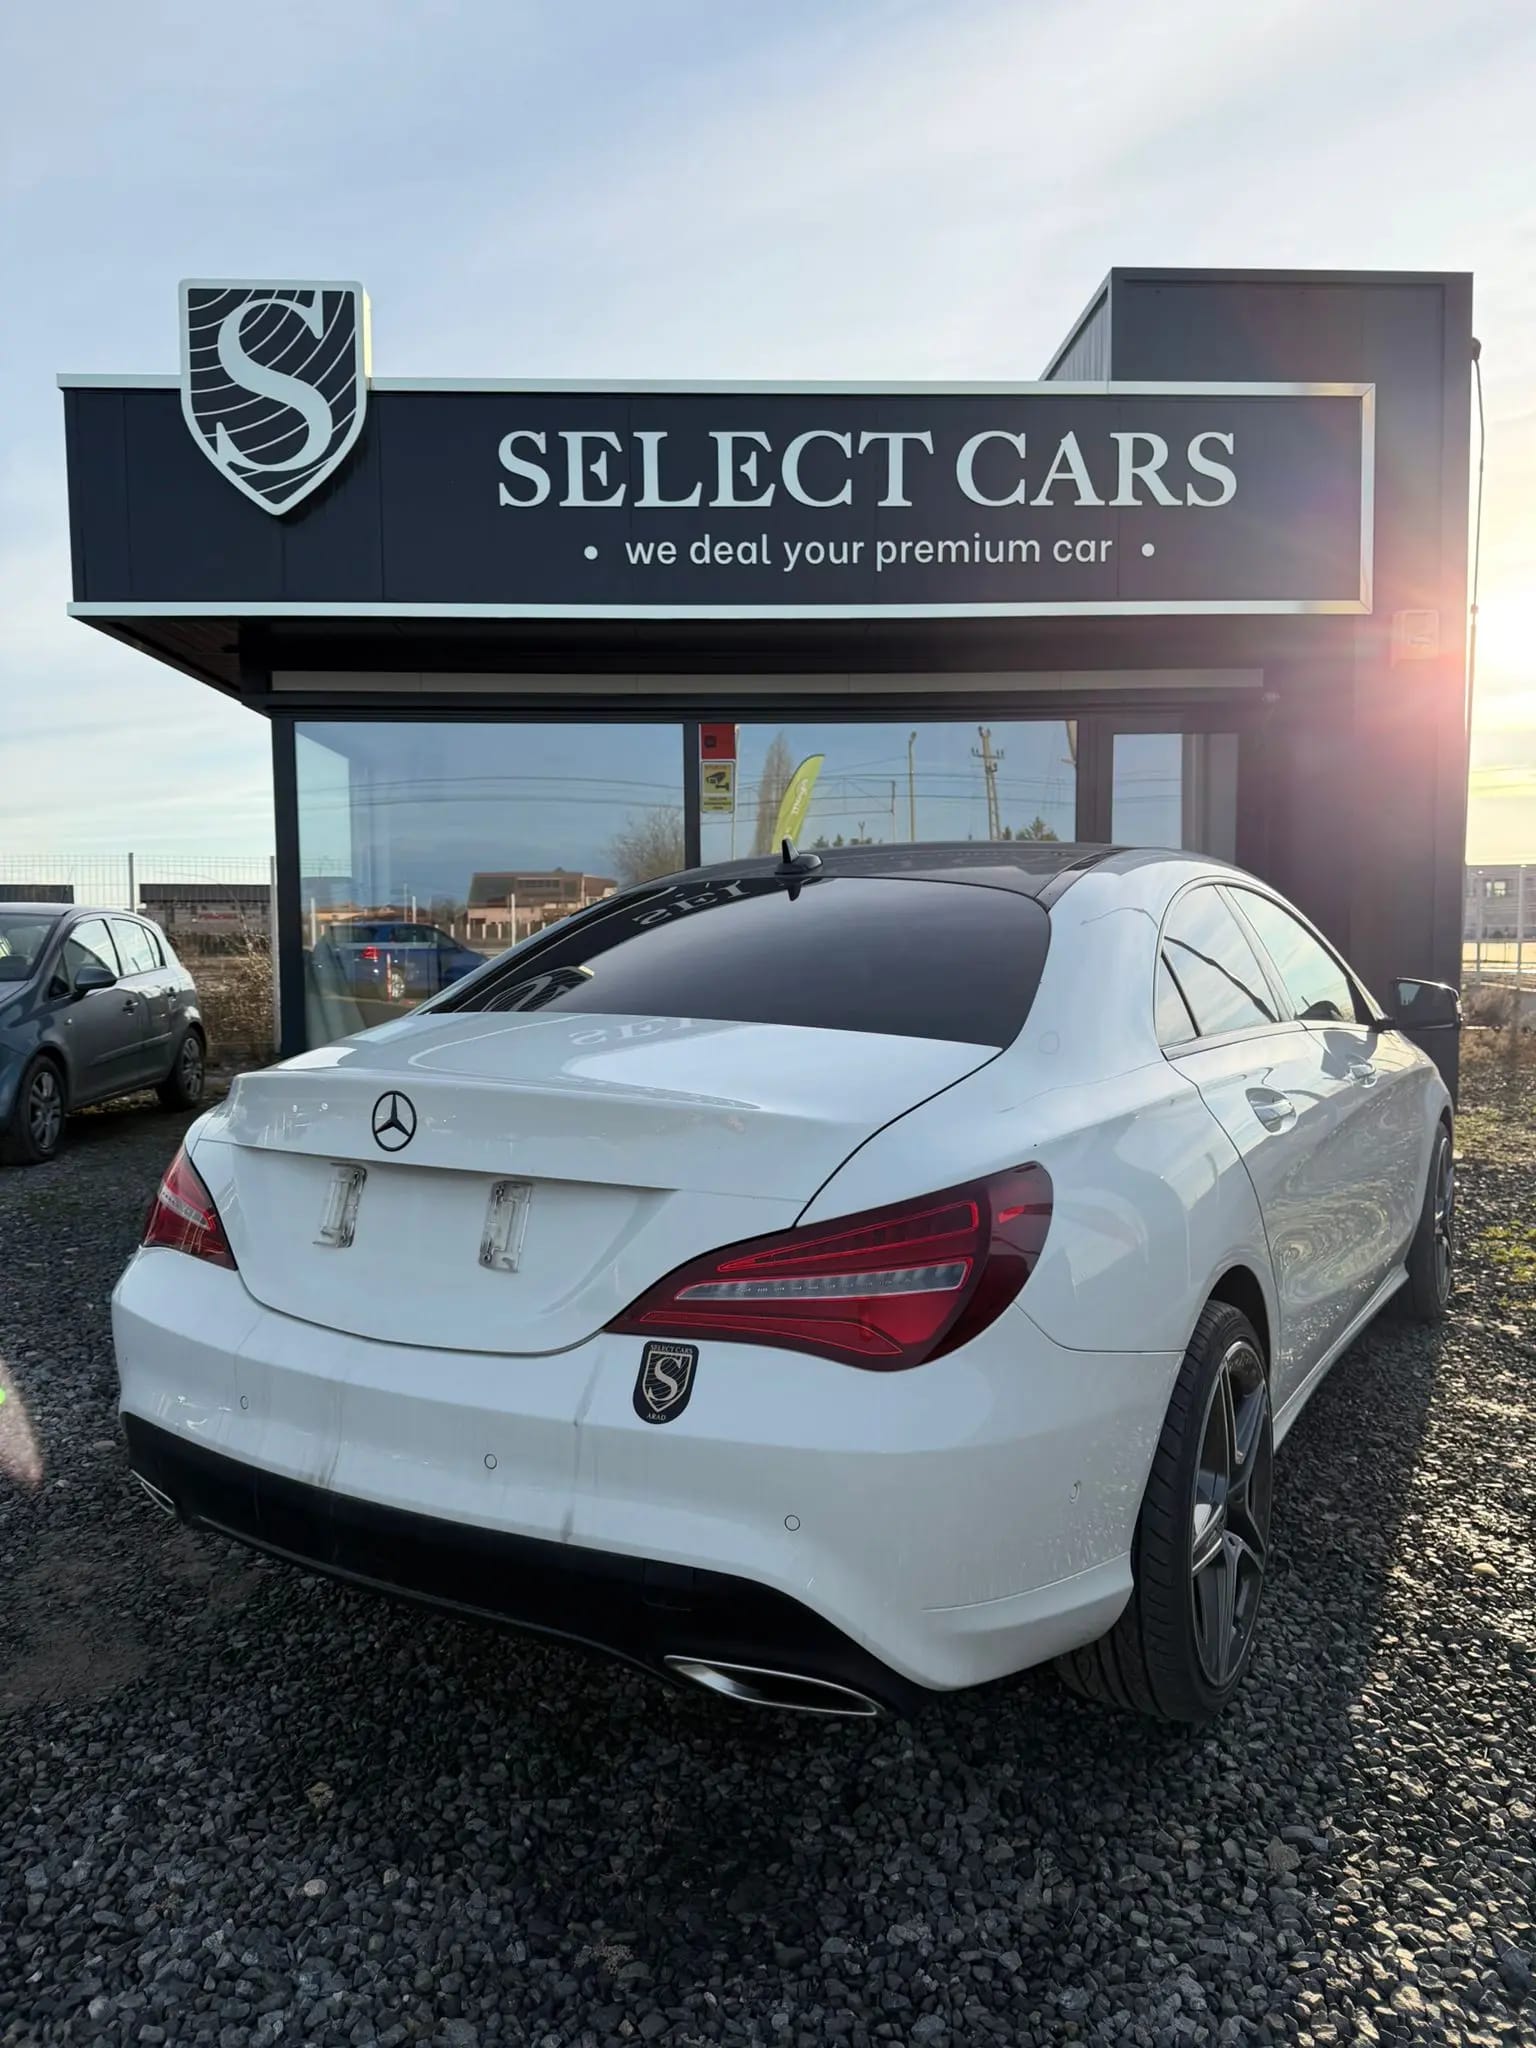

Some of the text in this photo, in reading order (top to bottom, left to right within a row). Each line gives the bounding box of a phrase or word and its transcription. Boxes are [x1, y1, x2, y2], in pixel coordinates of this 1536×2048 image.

[216, 290, 333, 473] S
[497, 430, 1238, 508] SELECT CARS
[625, 532, 1113, 572] we deal your premium car
[650, 1344, 674, 1352] SELECT
[647, 1356, 682, 1401] S
[646, 1413, 666, 1421] ARAD
